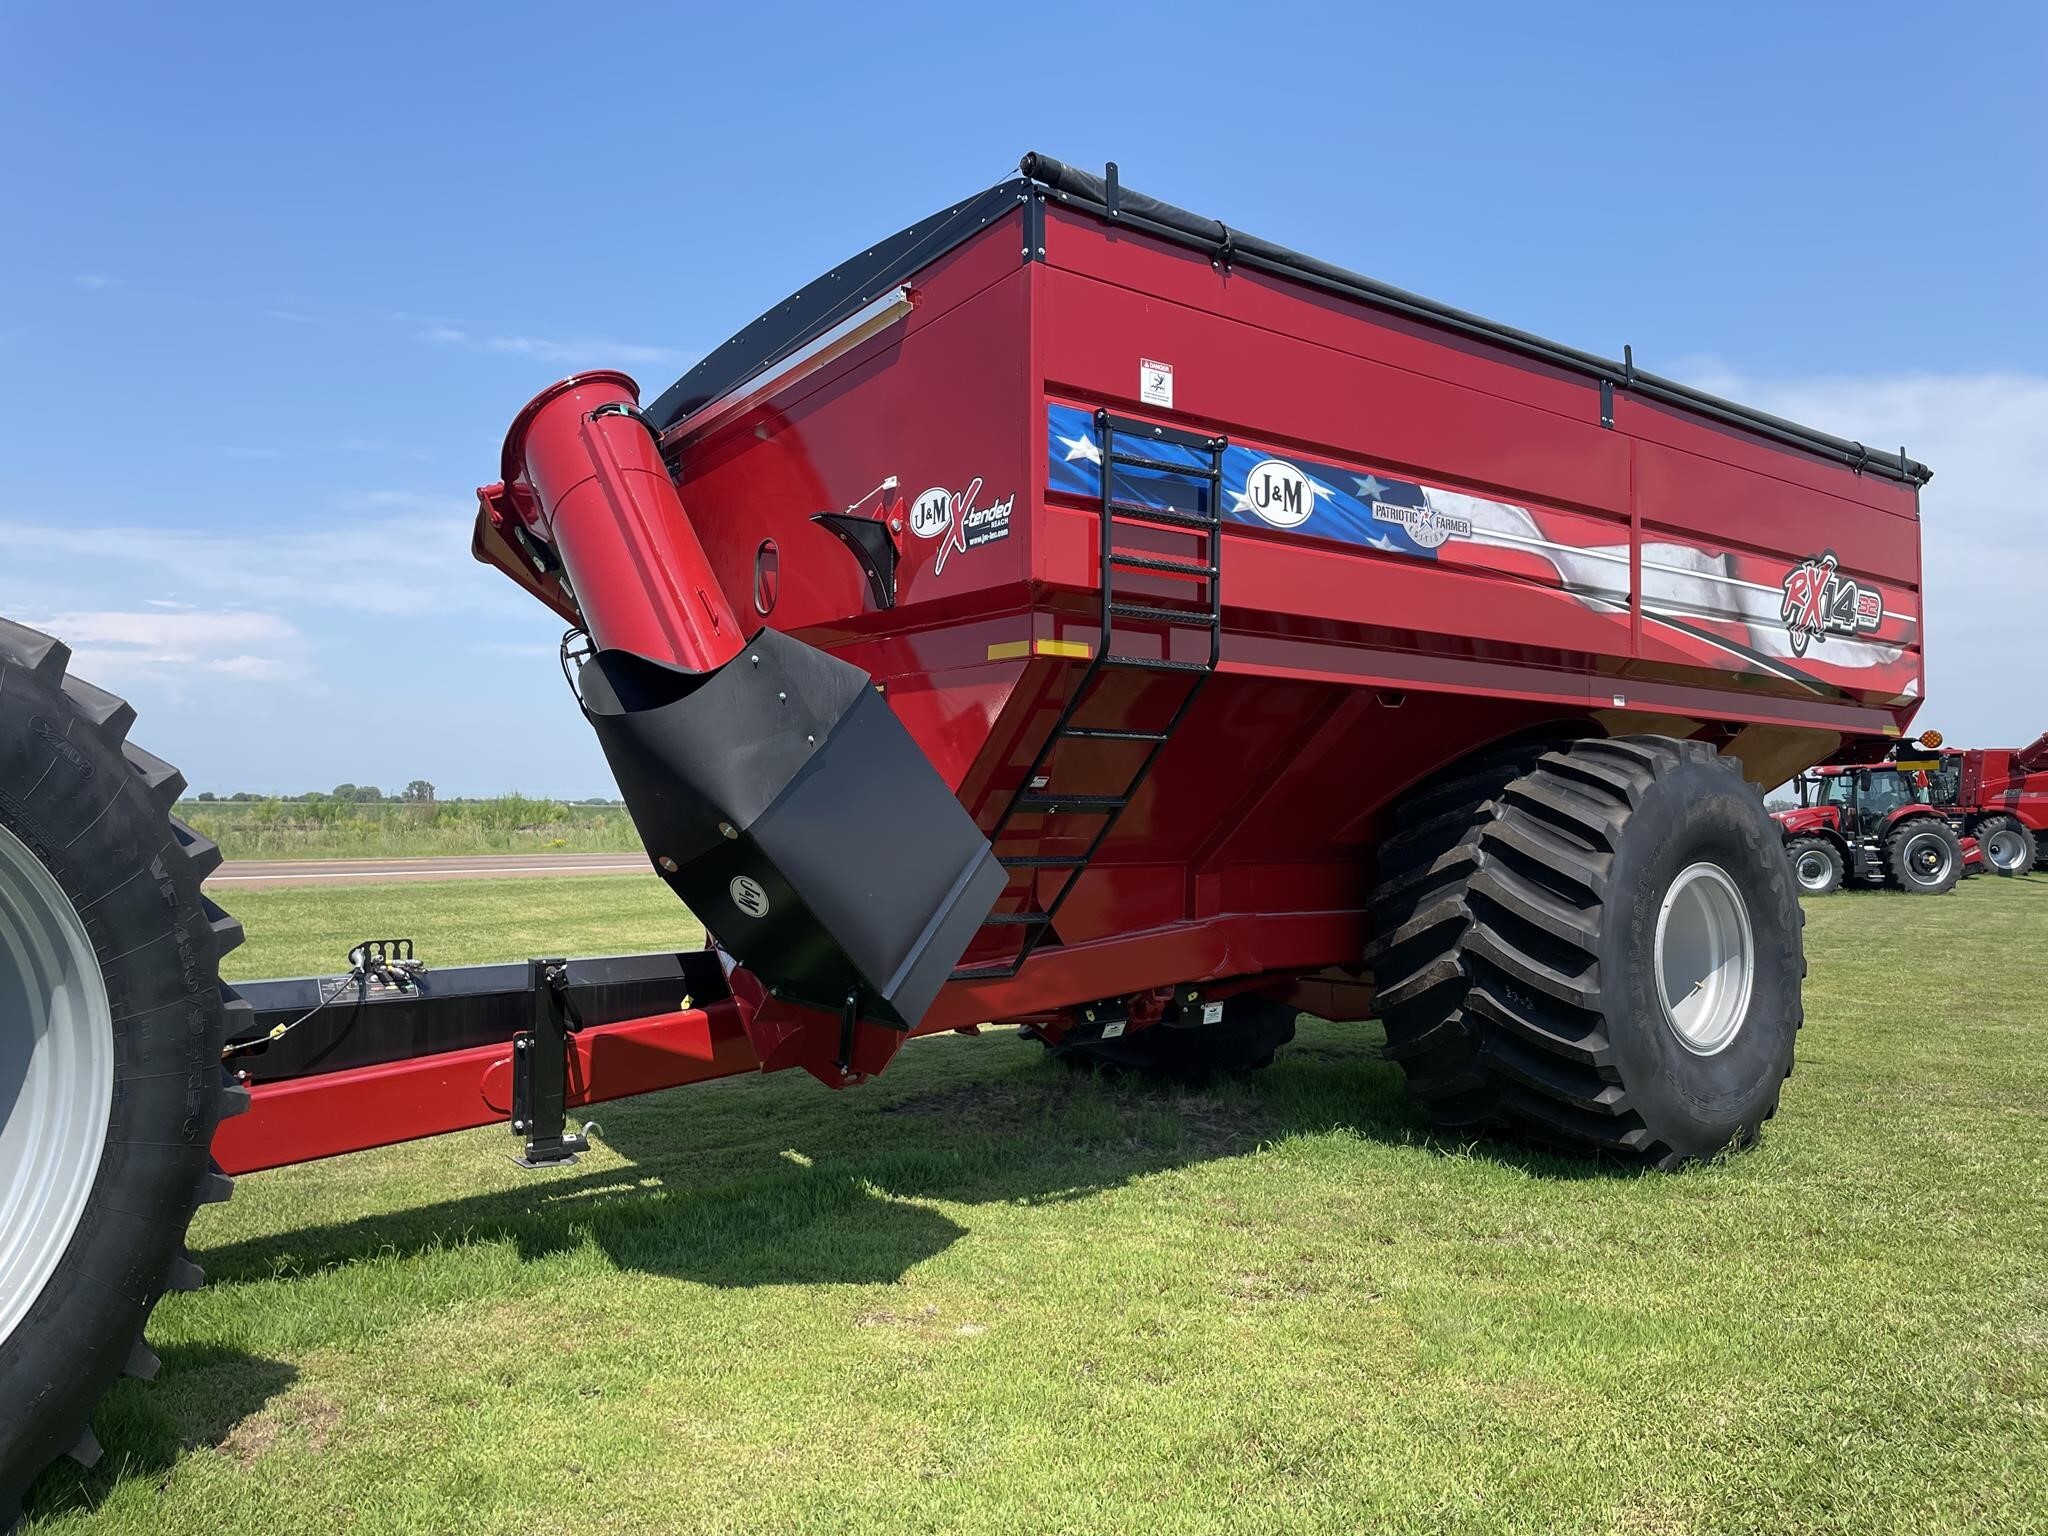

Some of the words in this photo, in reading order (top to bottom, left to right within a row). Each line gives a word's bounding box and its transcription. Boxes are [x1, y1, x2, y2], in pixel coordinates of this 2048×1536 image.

[1150, 361, 1171, 372] DANGER
[1254, 474, 1303, 515] J&M
[915, 496, 946, 530] J&M
[990, 517, 1009, 529] REACH
[1375, 504, 1418, 524] PATRIOTIC
[1436, 516, 1468, 534] FARMER
[1857, 595, 1879, 618] 32
[738, 880, 761, 913] J&M
